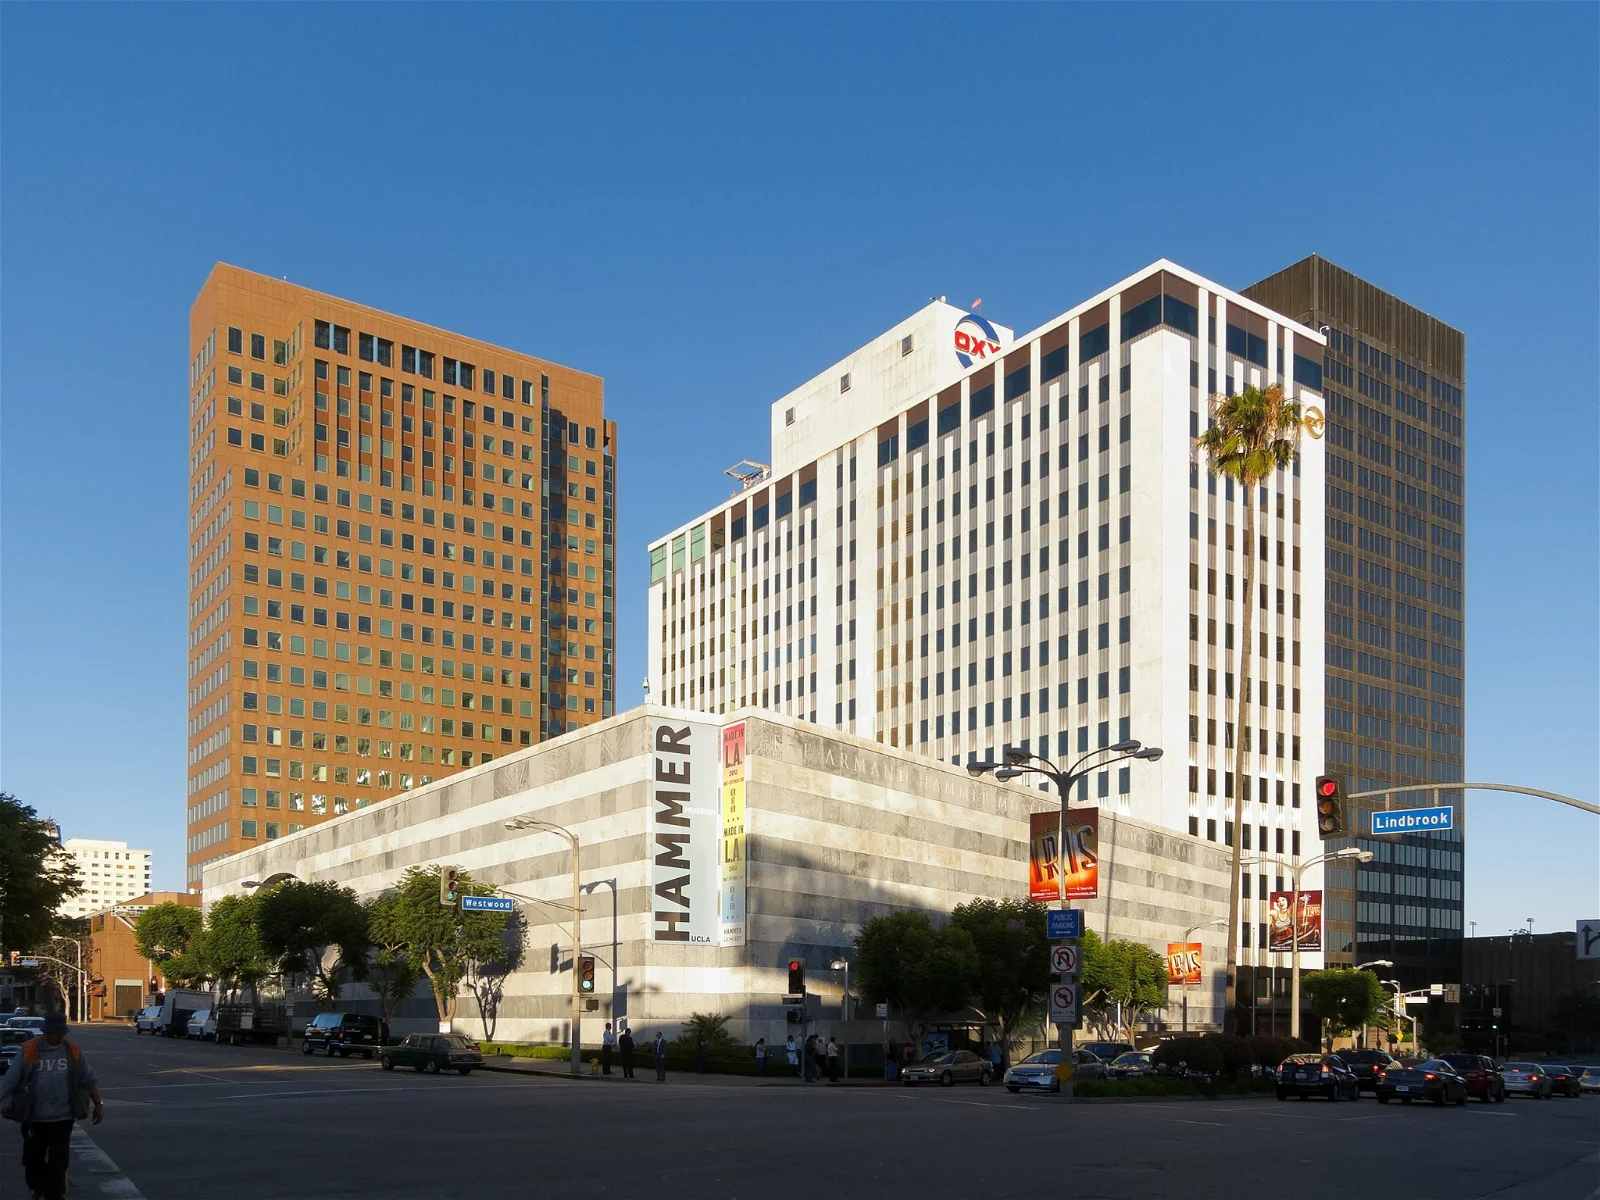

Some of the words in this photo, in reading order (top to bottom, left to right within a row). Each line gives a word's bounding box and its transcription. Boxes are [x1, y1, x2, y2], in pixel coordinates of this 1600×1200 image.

[723, 730, 737, 742] MADE
[825, 748, 909, 783] ARMAND
[919, 776, 989, 805] HAMMER
[1376, 812, 1448, 829] Lindbrook
[655, 725, 692, 941] HAMMER
[723, 826, 737, 837] MADE
[1030, 824, 1097, 884] IRIS
[465, 899, 510, 909] Westwood
[1053, 913, 1073, 921] PUBLIC
[1051, 921, 1075, 929] PARKING
[691, 935, 711, 943] UCLA
